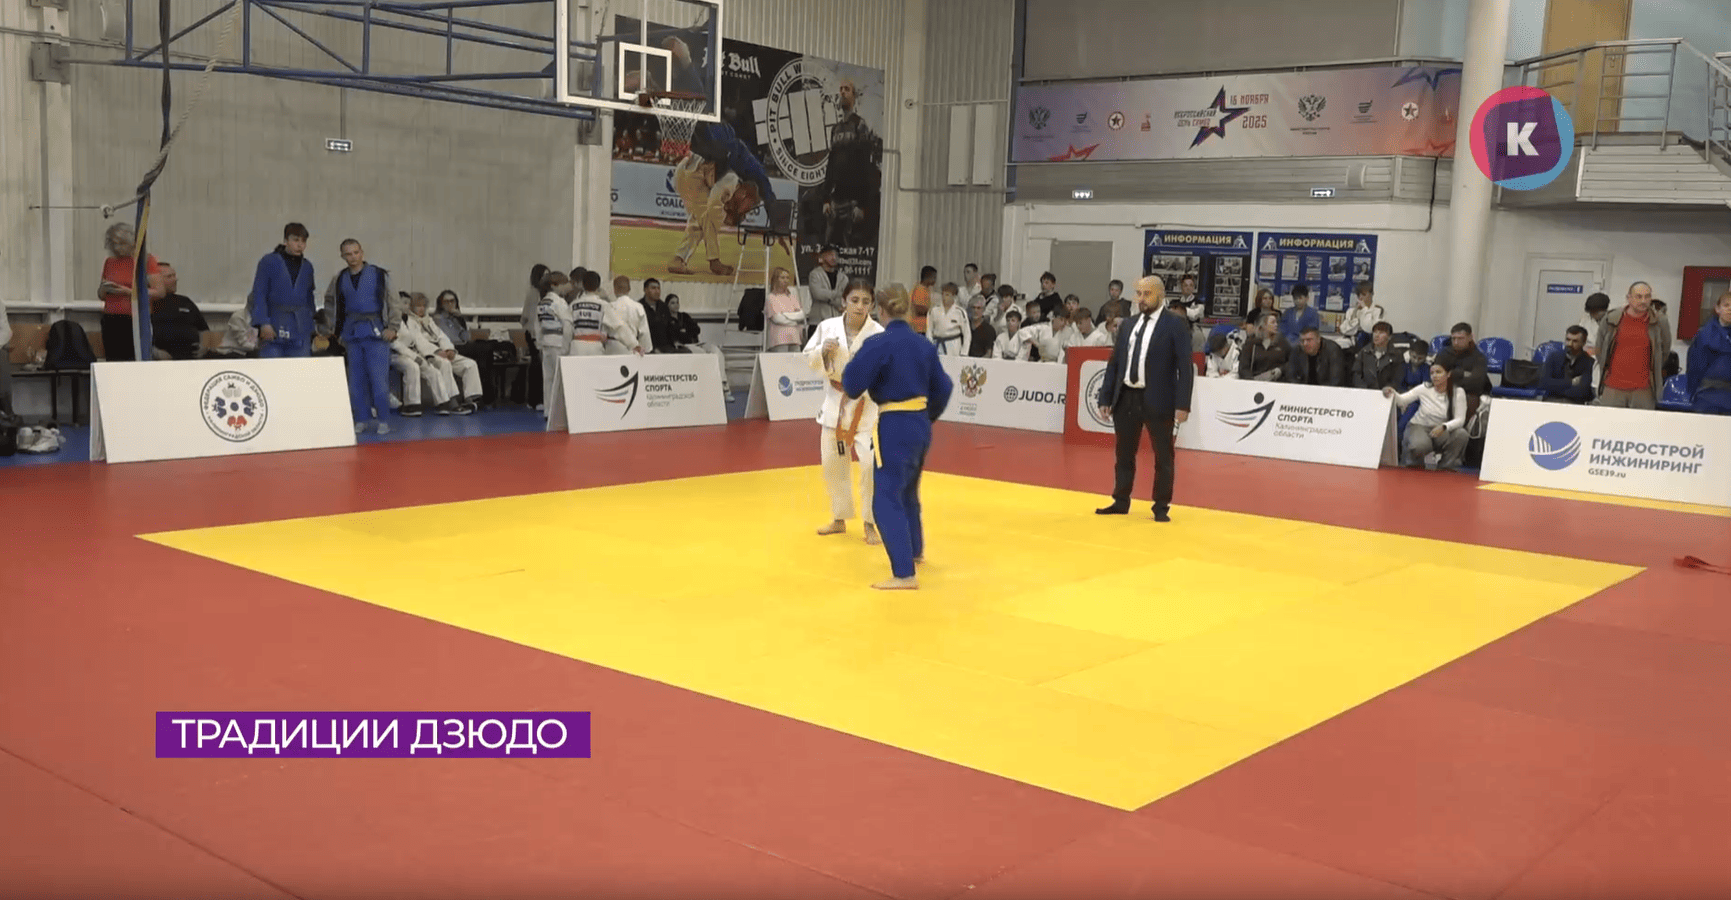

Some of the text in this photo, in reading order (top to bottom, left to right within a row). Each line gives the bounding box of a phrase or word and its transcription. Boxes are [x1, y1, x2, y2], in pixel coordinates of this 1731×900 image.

[728, 52, 761, 78] Bull
[769, 69, 793, 134] PIT BULL
[1230, 94, 1269, 105] 16 НОЯБРЯ
[1242, 115, 1267, 129] 2025
[775, 147, 827, 181] SINCE EIGHT
[656, 196, 685, 209] COALC
[1164, 234, 1232, 245] ИНФОРМАЦИЯ
[1279, 237, 1354, 249] ИНФОРМАЦИЯ
[223, 375, 246, 383] САМБО
[644, 374, 698, 382] МИНИСТЕРСТВО
[645, 384, 672, 392] СПОРТА
[1018, 388, 1067, 405] JUDO.R
[1279, 404, 1354, 418] МИНИСТЕРСТВО
[1277, 414, 1314, 424] СПОРТА
[1273, 430, 1304, 439] области
[1275, 423, 1342, 436] Калининградской
[1591, 438, 1705, 459] ГИДРОСТРОЙ
[1589, 454, 1703, 474] ИНЖИНИРИНГ
[1588, 467, 1626, 478] GSE39.ru
